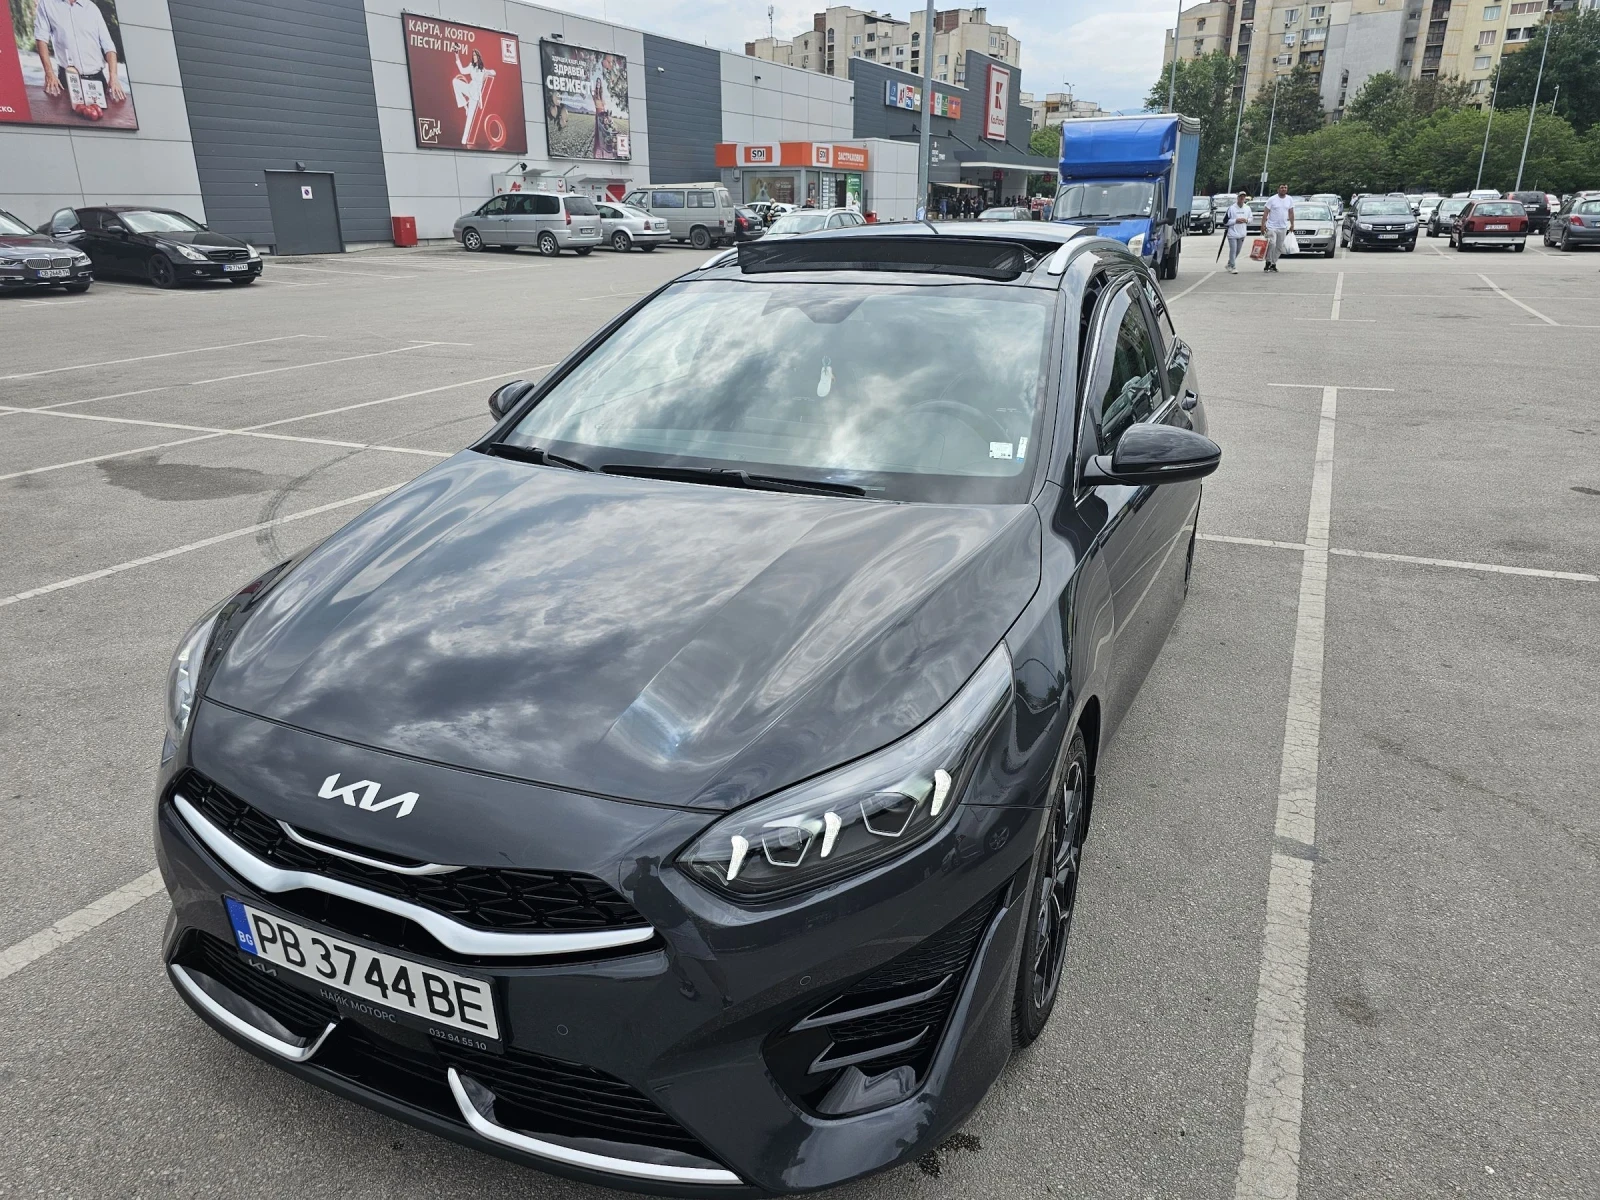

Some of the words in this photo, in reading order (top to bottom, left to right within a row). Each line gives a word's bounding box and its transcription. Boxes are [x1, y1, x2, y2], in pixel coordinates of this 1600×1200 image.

[408, 20, 443, 38] КАРТА,
[444, 27, 476, 42] КОЯТО
[410, 34, 442, 50] ПЕСТИ
[443, 41, 469, 55] ПАРИ
[422, 120, 442, 140] Card
[751, 149, 765, 158] SDI
[819, 150, 827, 159] SDI
[317, 772, 420, 819] KIA
[237, 930, 254, 946] BG
[311, 937, 417, 1009] 3744
[320, 988, 350, 1008] НАЙК
[350, 1001, 397, 1024] МОТОРС
[429, 1027, 447, 1040] 032
[447, 1033, 460, 1044] 94
[461, 1037, 474, 1048] 55
[475, 1041, 487, 1051] 10
